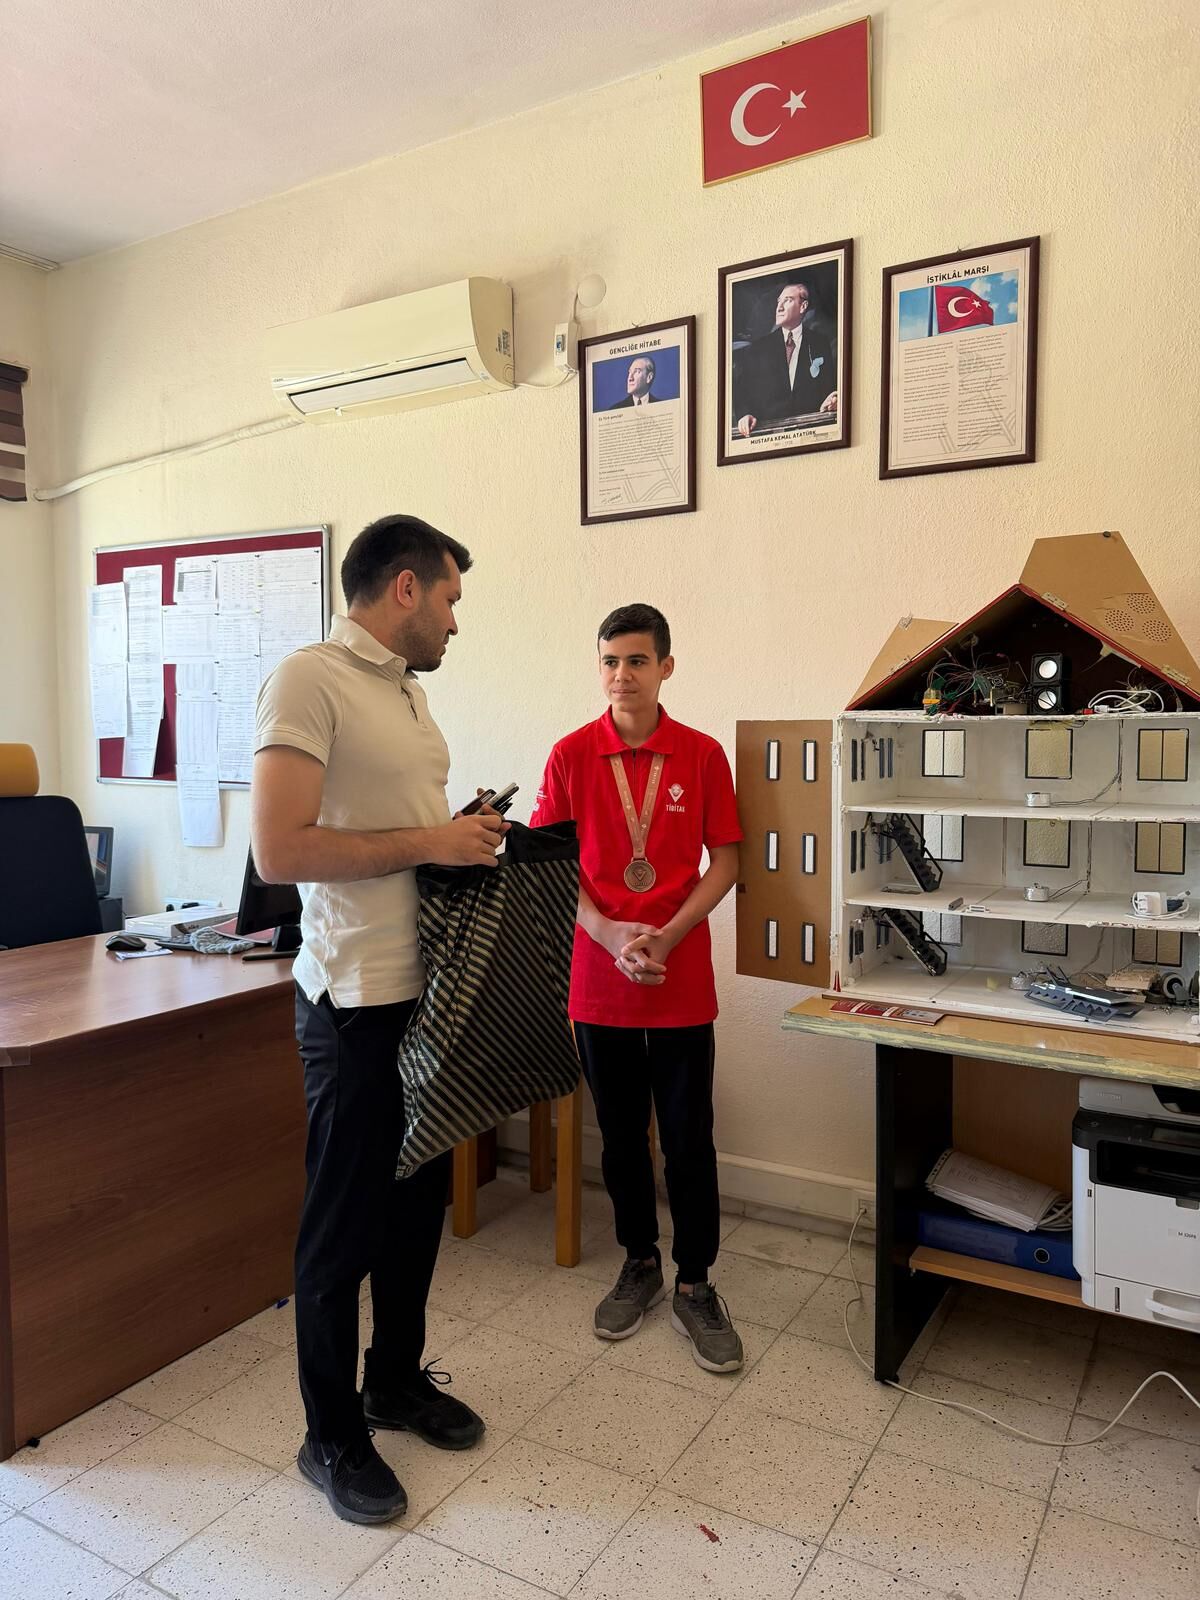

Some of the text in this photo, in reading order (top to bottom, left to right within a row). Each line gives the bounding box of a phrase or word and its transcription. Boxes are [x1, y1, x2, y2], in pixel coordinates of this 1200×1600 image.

[927, 265, 989, 284] İSTİKLÂL MARŞI
[609, 339, 662, 355] GENÇLİĞE HİTABE
[750, 437, 774, 445] MUSTAFA
[774, 434, 791, 442] KEMAL
[792, 430, 816, 439] ATATÜRK
